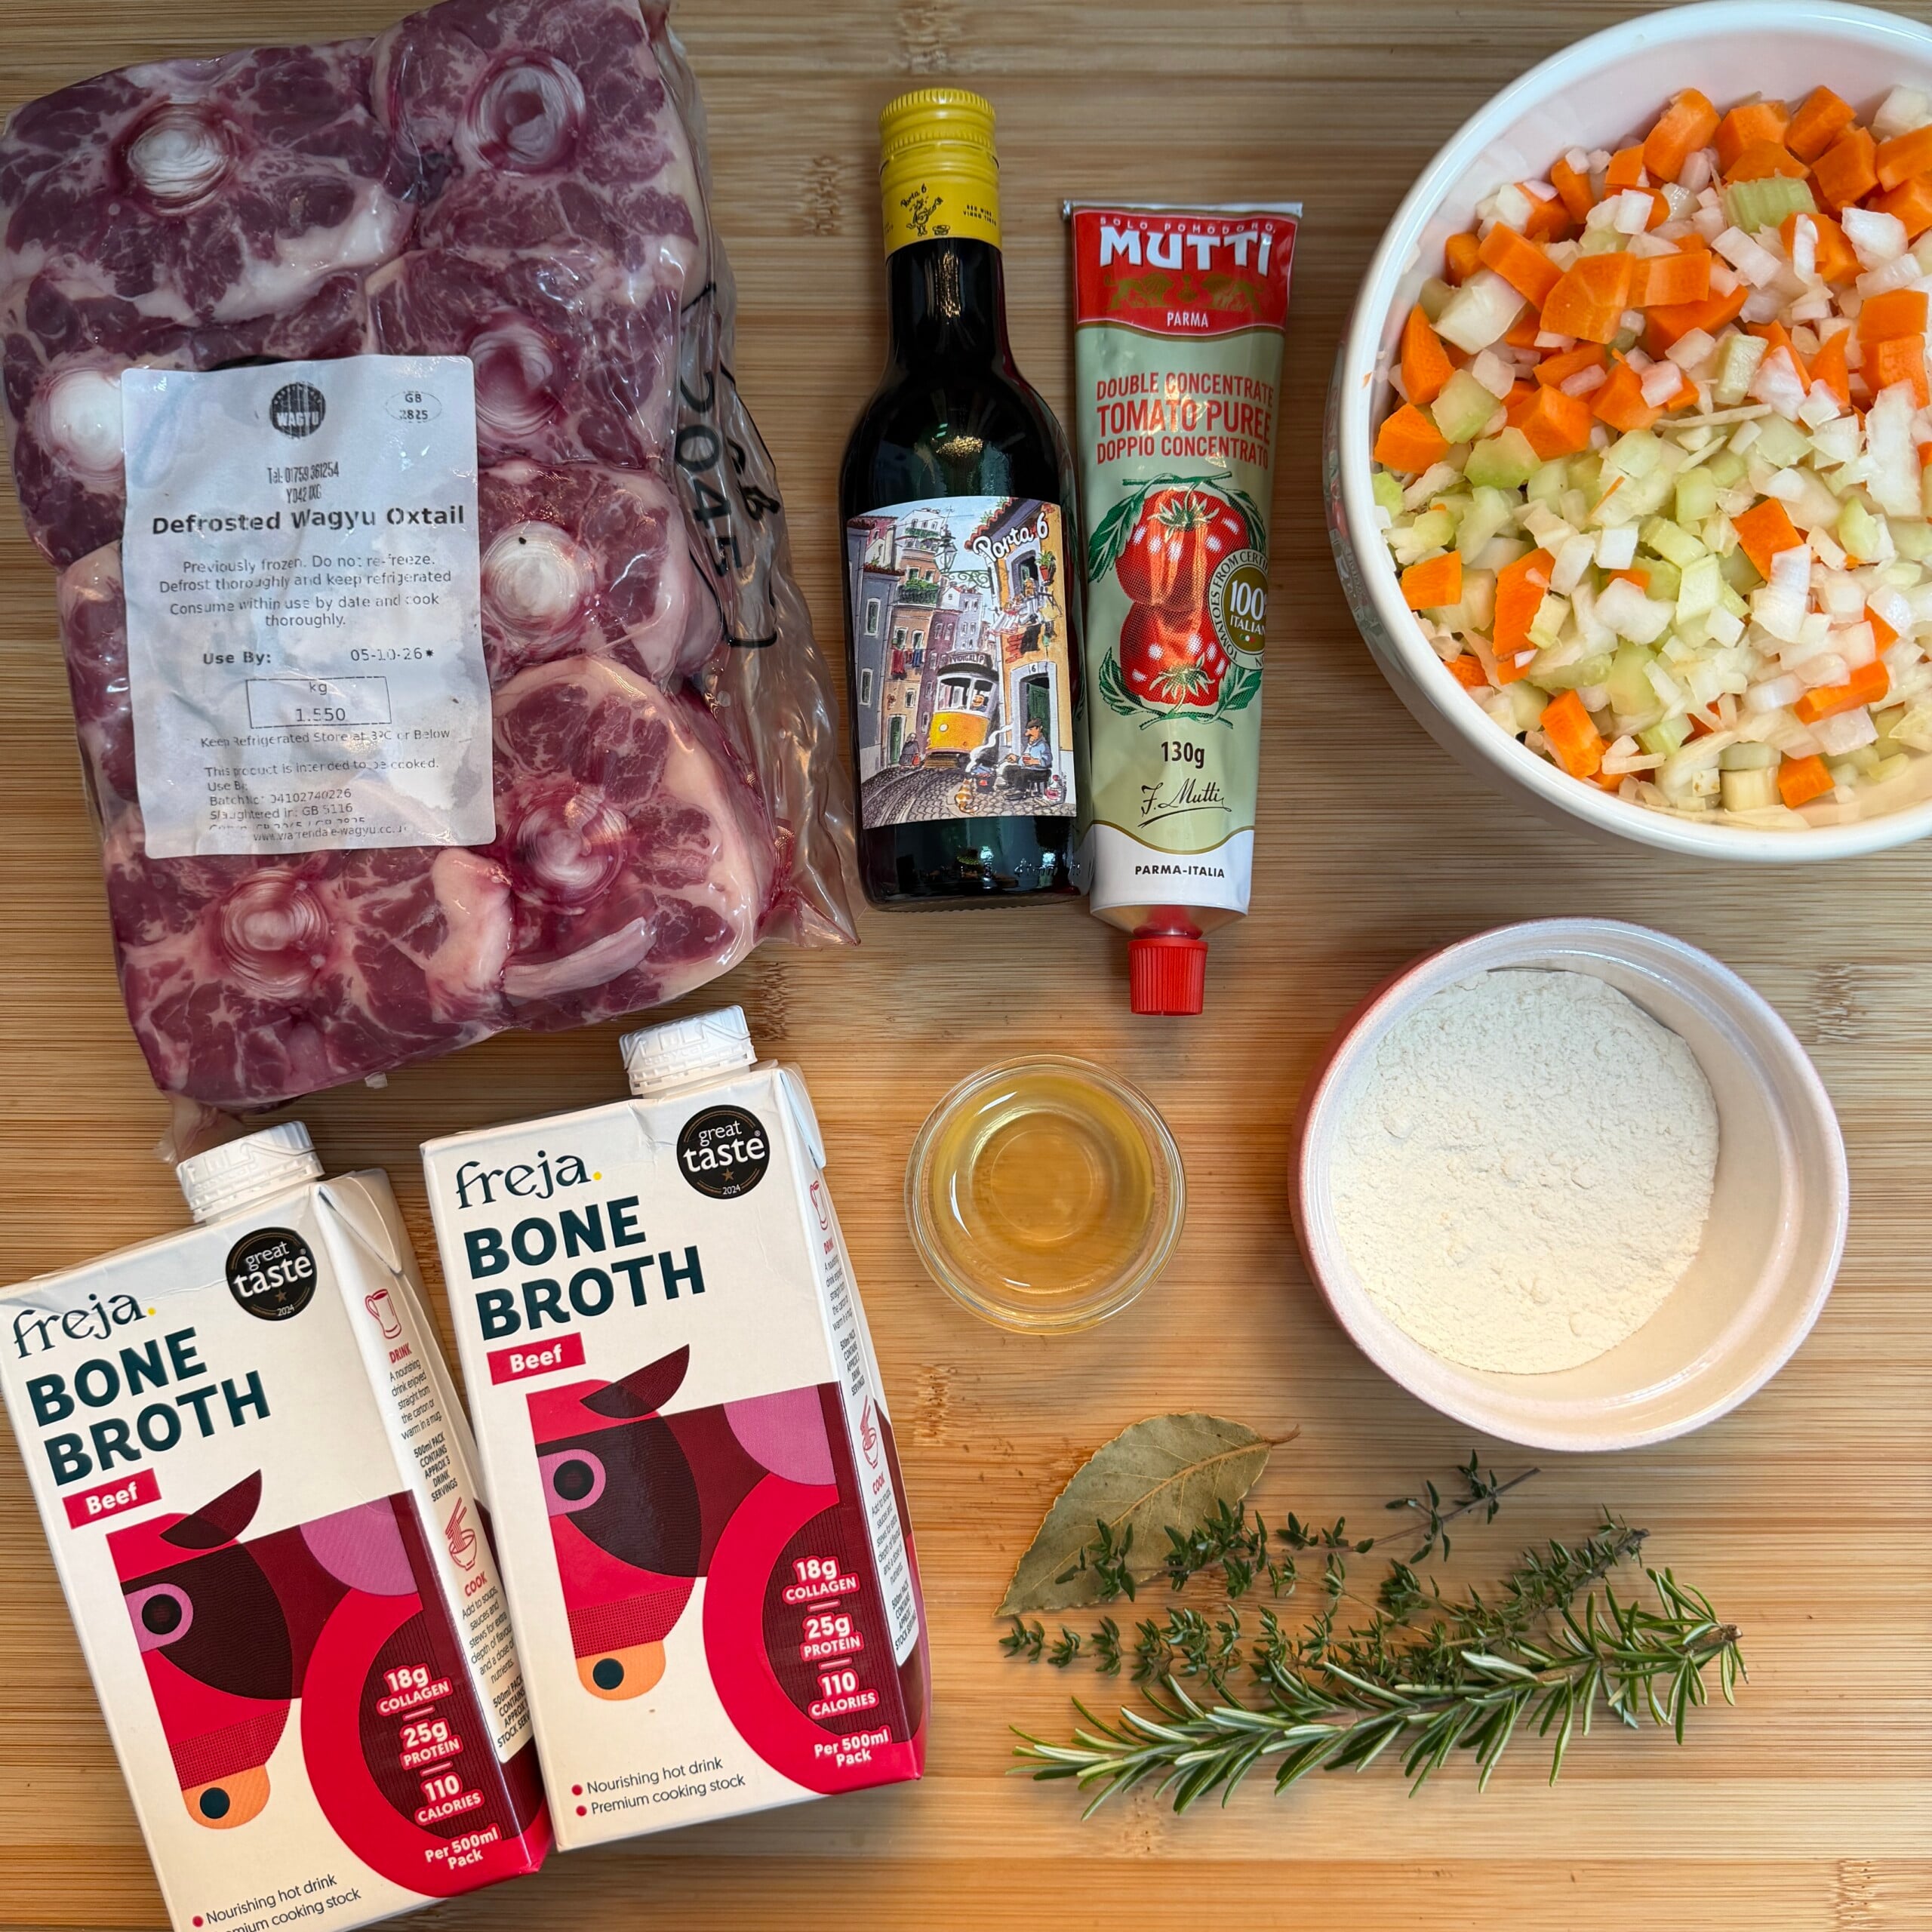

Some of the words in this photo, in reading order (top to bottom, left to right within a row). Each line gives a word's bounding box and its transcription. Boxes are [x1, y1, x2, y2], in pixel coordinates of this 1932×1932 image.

[921, 183, 927, 193] 6
[1100, 226, 1272, 277] MUTTI
[1167, 312, 1209, 328] PARMA
[405, 393, 422, 403] GB
[1097, 373, 1159, 401] DOUBLE
[1165, 372, 1274, 408] CONCENTRATE
[276, 411, 319, 427] WAGYU
[1097, 399, 1198, 437] TOMATO
[1207, 399, 1272, 445] PUREE
[1097, 436, 1155, 465] DOPPIO
[1161, 436, 1269, 470] CONCENTRATO
[310, 460, 340, 480] 361254
[152, 510, 281, 534] Defrosted
[291, 508, 376, 531] Wagyu
[386, 505, 466, 526] Oxtail
[972, 521, 1034, 565] Porta
[1035, 512, 1050, 540] 6
[183, 558, 256, 574] Previously
[262, 557, 307, 571] frozen.
[312, 555, 332, 568] Do
[1213, 555, 1239, 589] FROM
[159, 579, 211, 593] Defrost
[216, 575, 290, 591] thoroughly
[294, 574, 321, 586] and
[327, 573, 362, 588] keep
[367, 570, 452, 586] refrigerated
[169, 602, 235, 615] Consume
[239, 597, 281, 610] within
[285, 598, 310, 610] use
[315, 595, 333, 611] by
[338, 595, 371, 608] date
[376, 594, 401, 607] and
[1229, 580, 1268, 621] 100
[266, 612, 346, 629] thoroughly.
[1211, 590, 1238, 663] TOMATOES
[203, 653, 235, 664] Use
[243, 651, 271, 666] By:
[309, 681, 328, 696] kg
[295, 707, 346, 722] 1.550
[200, 737, 230, 748] Keep
[233, 732, 309, 747] Refrigerated
[313, 731, 348, 742] Store
[352, 732, 365, 741] at
[414, 728, 451, 740] Below
[1161, 741, 1204, 769] 130g
[204, 767, 230, 777] This
[281, 763, 293, 774] is
[353, 760, 367, 770] to
[208, 782, 231, 792] Use
[210, 794, 245, 806] Batch
[302, 805, 318, 816] GB
[1135, 864, 1225, 878] PARMA-ITALIA
[699, 1121, 743, 1147] great
[682, 1137, 766, 1173] taste
[722, 1185, 741, 1195] 2024
[463, 1195, 647, 1280] BONE
[245, 1241, 291, 1272] great
[234, 1254, 313, 1298] taste
[475, 1245, 706, 1341] BROTH
[277, 1303, 295, 1316] 2024
[389, 1342, 412, 1364] DRINK
[509, 1343, 563, 1374] Beef
[25, 1326, 208, 1428] BONE
[389, 1371, 395, 1383] A
[395, 1358, 422, 1380] nourishing
[391, 1381, 408, 1397] drink
[408, 1369, 427, 1389] enjoyed
[398, 1391, 420, 1411] straight
[43, 1370, 272, 1487] BROTH
[401, 1412, 414, 1425] the
[401, 1423, 421, 1441] warm
[414, 1439, 432, 1458] 500ml
[431, 1430, 446, 1447] PACK
[420, 1443, 448, 1468] CONTAINS
[424, 1457, 448, 1480] APPROX
[431, 1477, 458, 1503] SERVINGS
[432, 1469, 451, 1488] DRINK
[85, 1481, 140, 1516] Beef
[796, 1557, 838, 1583] 18g
[464, 1571, 488, 1598] COOK
[786, 1577, 857, 1601] COLLAGEN
[462, 1601, 476, 1620] Add
[469, 1610, 490, 1631] sauces
[489, 1598, 500, 1616] and
[469, 1629, 488, 1649] stews
[806, 1614, 851, 1639] 25g
[471, 1642, 491, 1665] depth
[803, 1635, 861, 1658] PROTEIN
[386, 1664, 431, 1694] 18g
[479, 1658, 493, 1675] and
[493, 1685, 512, 1708] 500ml
[820, 1671, 857, 1697] 110
[379, 1681, 451, 1715] COLLAGEN
[811, 1691, 876, 1718] CALORIES
[503, 1701, 526, 1729] APPROX
[403, 1719, 449, 1749] 25g
[497, 1723, 519, 1749] STOCK
[814, 1740, 839, 1758] Per
[841, 1728, 890, 1752] 500ml
[403, 1739, 460, 1767] PROTEIN
[836, 1748, 872, 1767] Pack
[424, 1774, 461, 1803] 110
[586, 1769, 660, 1795] Nourishing
[662, 1763, 687, 1780] hot
[688, 1756, 724, 1775] drink
[417, 1792, 482, 1823] CALORIES
[591, 1795, 650, 1816] Premium
[651, 1781, 707, 1805] cooking
[709, 1773, 746, 1792] stock
[424, 1844, 450, 1863] Per
[451, 1827, 500, 1854] 500ml
[448, 1848, 484, 1870] Pack
[205, 1894, 276, 1924] Nourishing
[278, 1885, 302, 1903] hot
[303, 1873, 337, 1894] drink
[271, 1900, 325, 1925] cooking
[326, 1887, 361, 1909] stock
